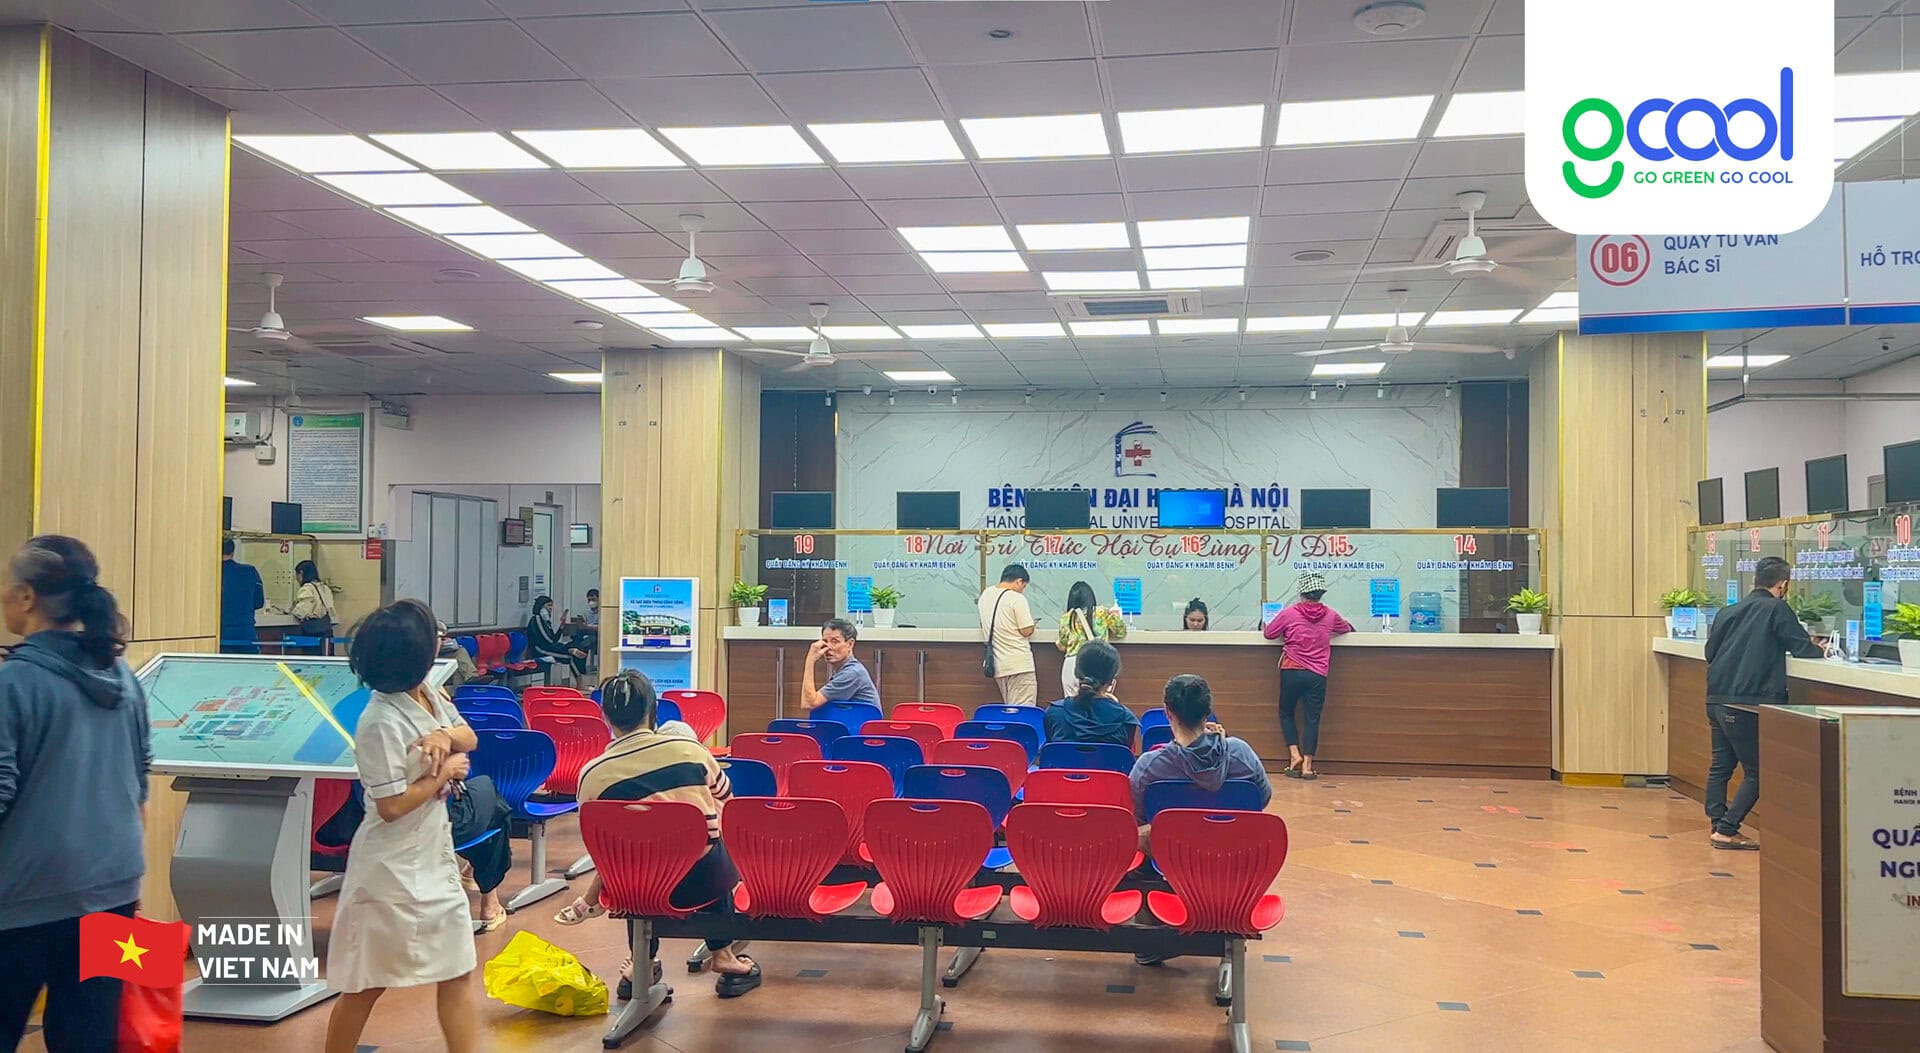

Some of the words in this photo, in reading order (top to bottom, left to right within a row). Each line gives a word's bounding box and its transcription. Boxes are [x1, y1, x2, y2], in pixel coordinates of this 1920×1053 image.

[1601, 242, 1639, 273] 06
[1665, 257, 1699, 274] BÁC
[1705, 255, 1720, 273] SĨ
[1861, 245, 1886, 267] HỖ
[1104, 488, 1139, 512] ĐẠI
[1251, 483, 1289, 512] NỘI
[1224, 516, 1290, 529] OSPITAL
[1895, 514, 1911, 545] 10
[280, 540, 289, 554] 25
[794, 535, 814, 554] 19
[905, 535, 924, 554] 18
[1044, 535, 1062, 554] 17
[1091, 533, 1143, 559] Hội
[1181, 535, 1200, 554] 16
[1327, 534, 1348, 554] 15
[1454, 534, 1477, 555] 14
[1880, 861, 1920, 879] NG
